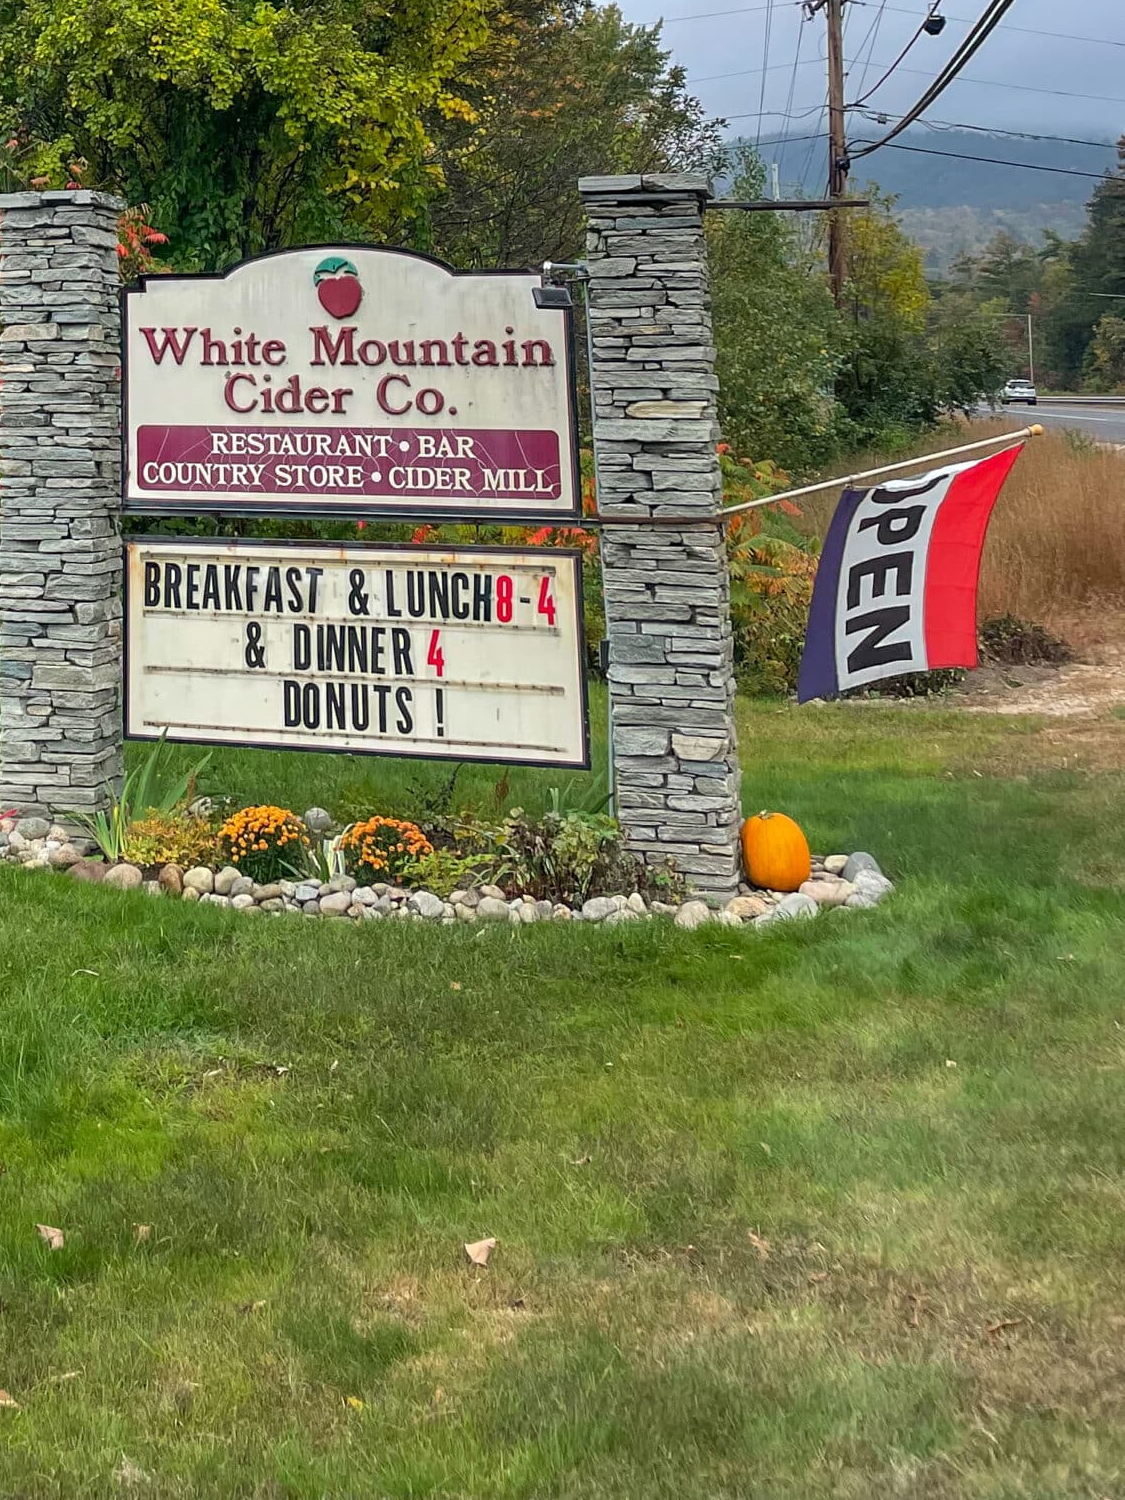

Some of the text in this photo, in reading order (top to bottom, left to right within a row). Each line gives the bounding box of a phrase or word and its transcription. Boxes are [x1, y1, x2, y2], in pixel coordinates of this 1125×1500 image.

[139, 326, 556, 368] White Mountain
[223, 372, 459, 417] Cider Co.
[211, 433, 476, 459] RESTAURANT BAR
[142, 462, 554, 493] COUNTRY STORE CIDER MILL
[144, 561, 324, 614] BREAKFAST
[348, 568, 370, 616] &
[245, 621, 445, 677] & DINNER 4
[284, 680, 413, 735] DONUTS
